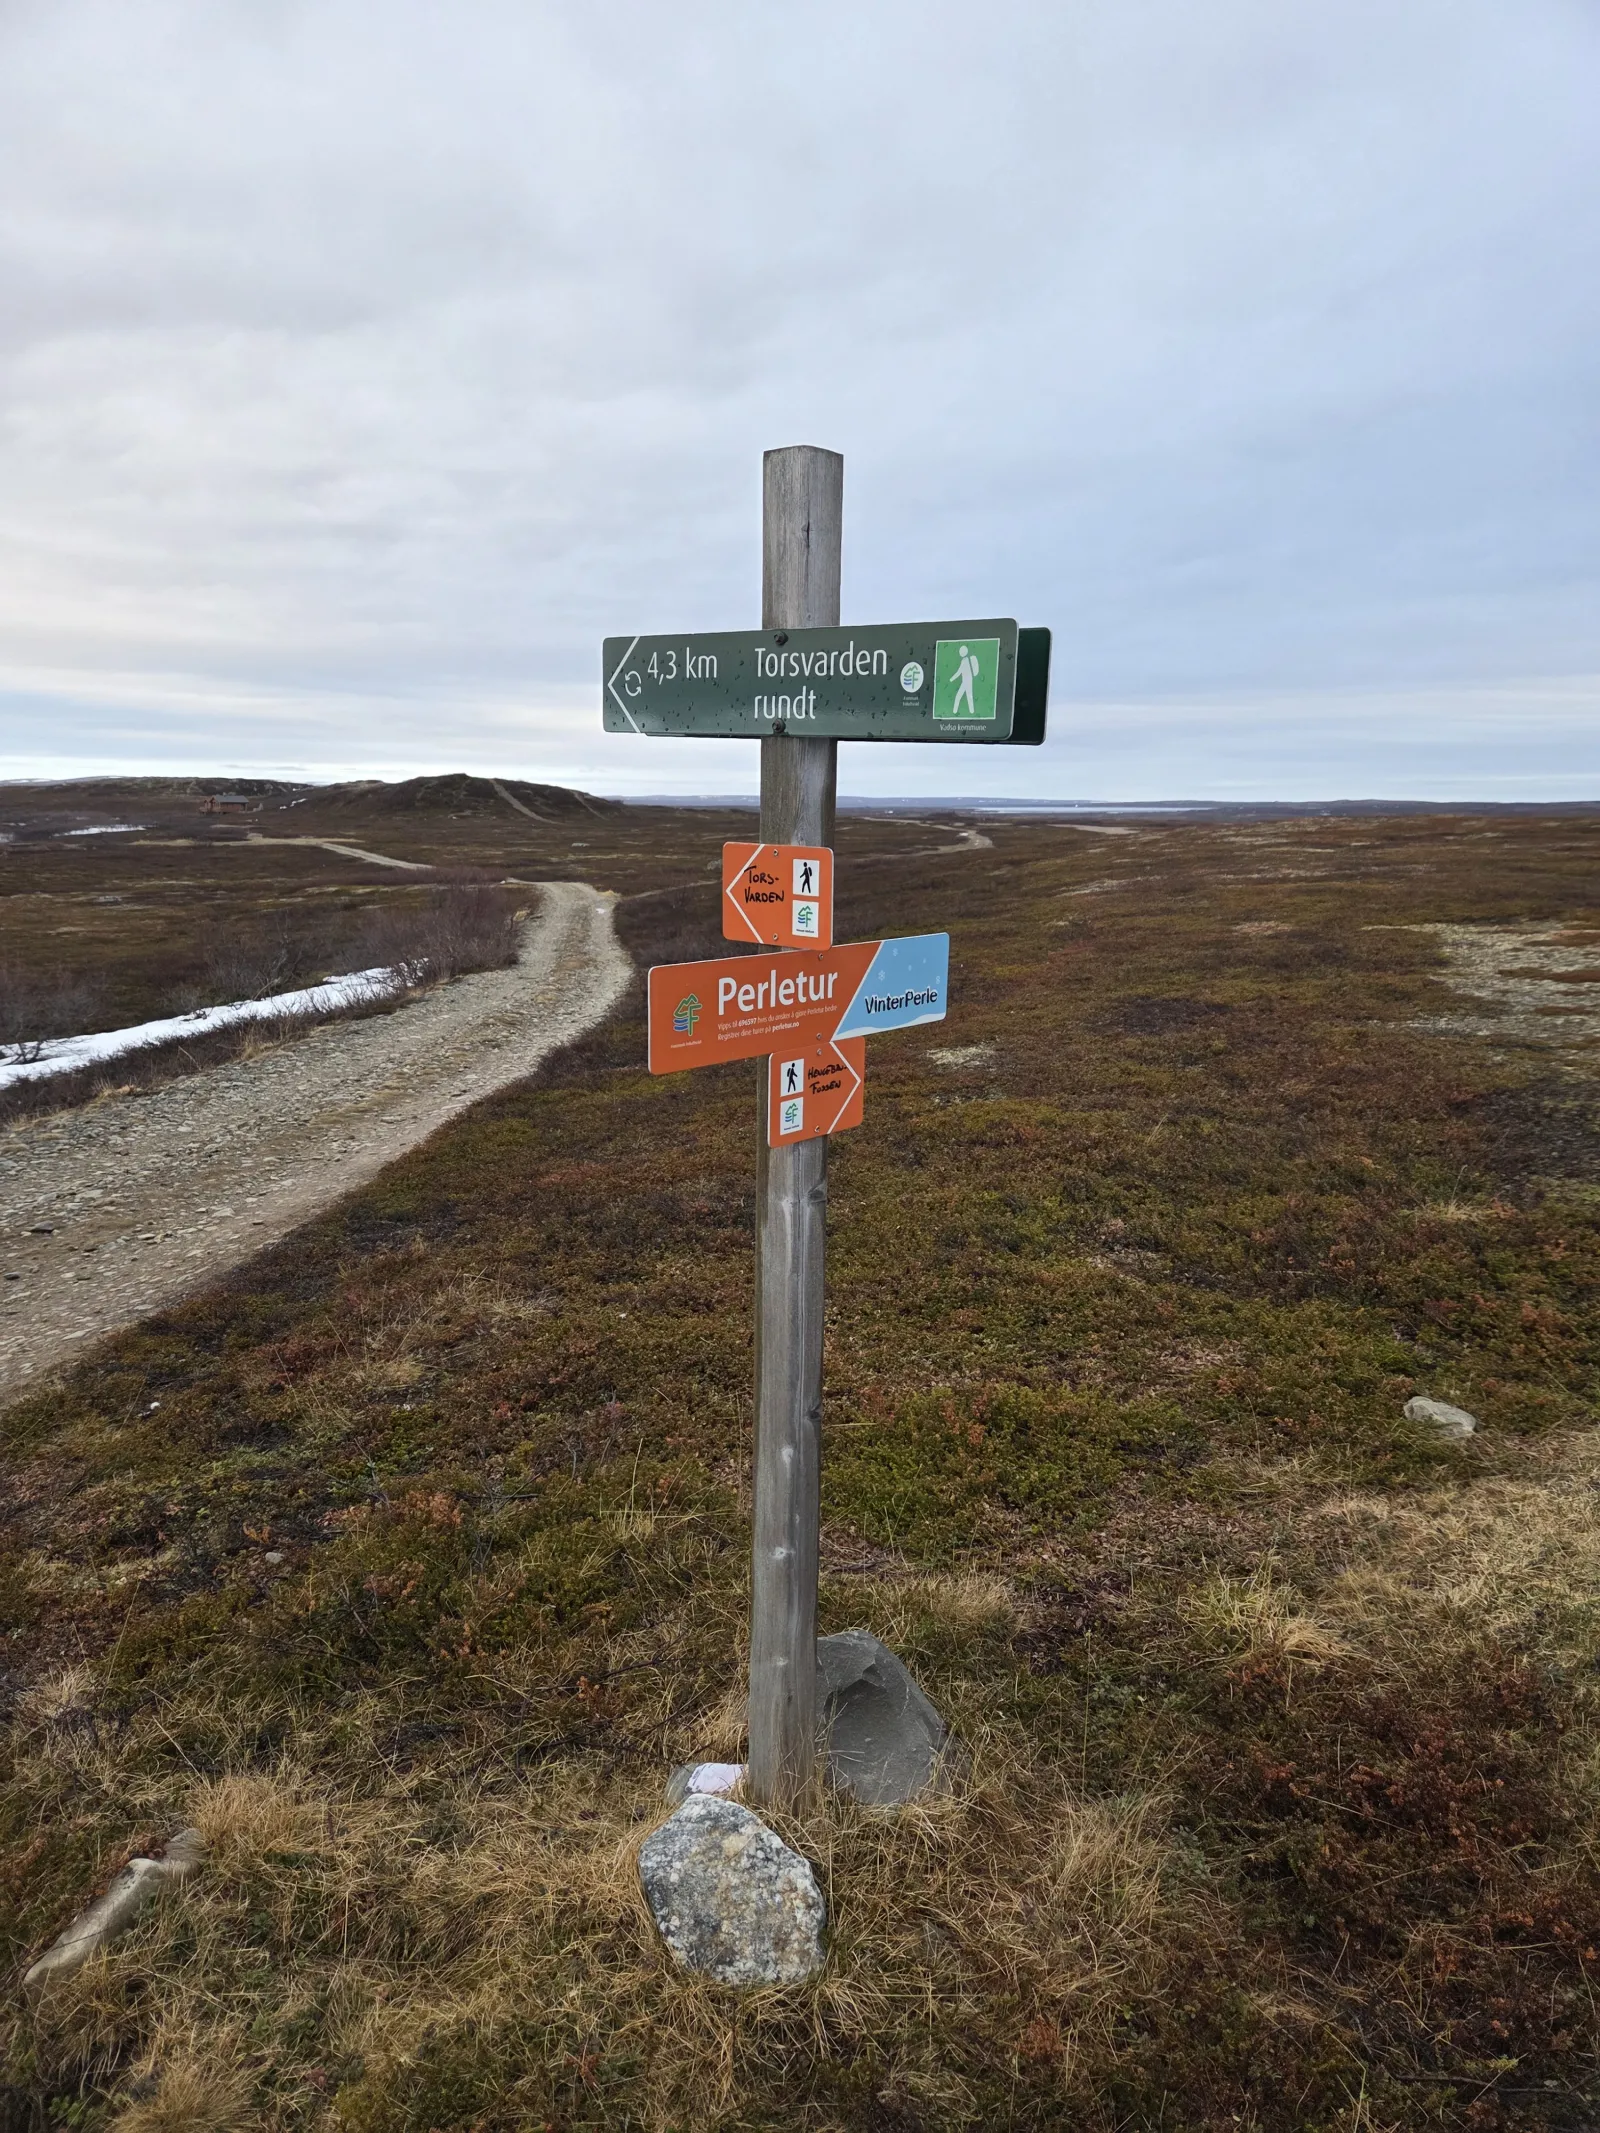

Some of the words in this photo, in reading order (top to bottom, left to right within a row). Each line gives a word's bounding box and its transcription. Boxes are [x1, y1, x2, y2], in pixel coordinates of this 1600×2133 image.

[647, 650, 678, 685] 4,3
[686, 647, 718, 679] km
[754, 640, 888, 678] Torsvarden
[754, 685, 817, 720] rundt
[957, 723, 987, 732] kommune
[717, 969, 839, 1016] Perletur
[864, 986, 939, 1015] VinterPerle
[717, 1023, 732, 1031] Vipps
[768, 1014, 775, 1022] du
[772, 1021, 800, 1033] perletur.no
